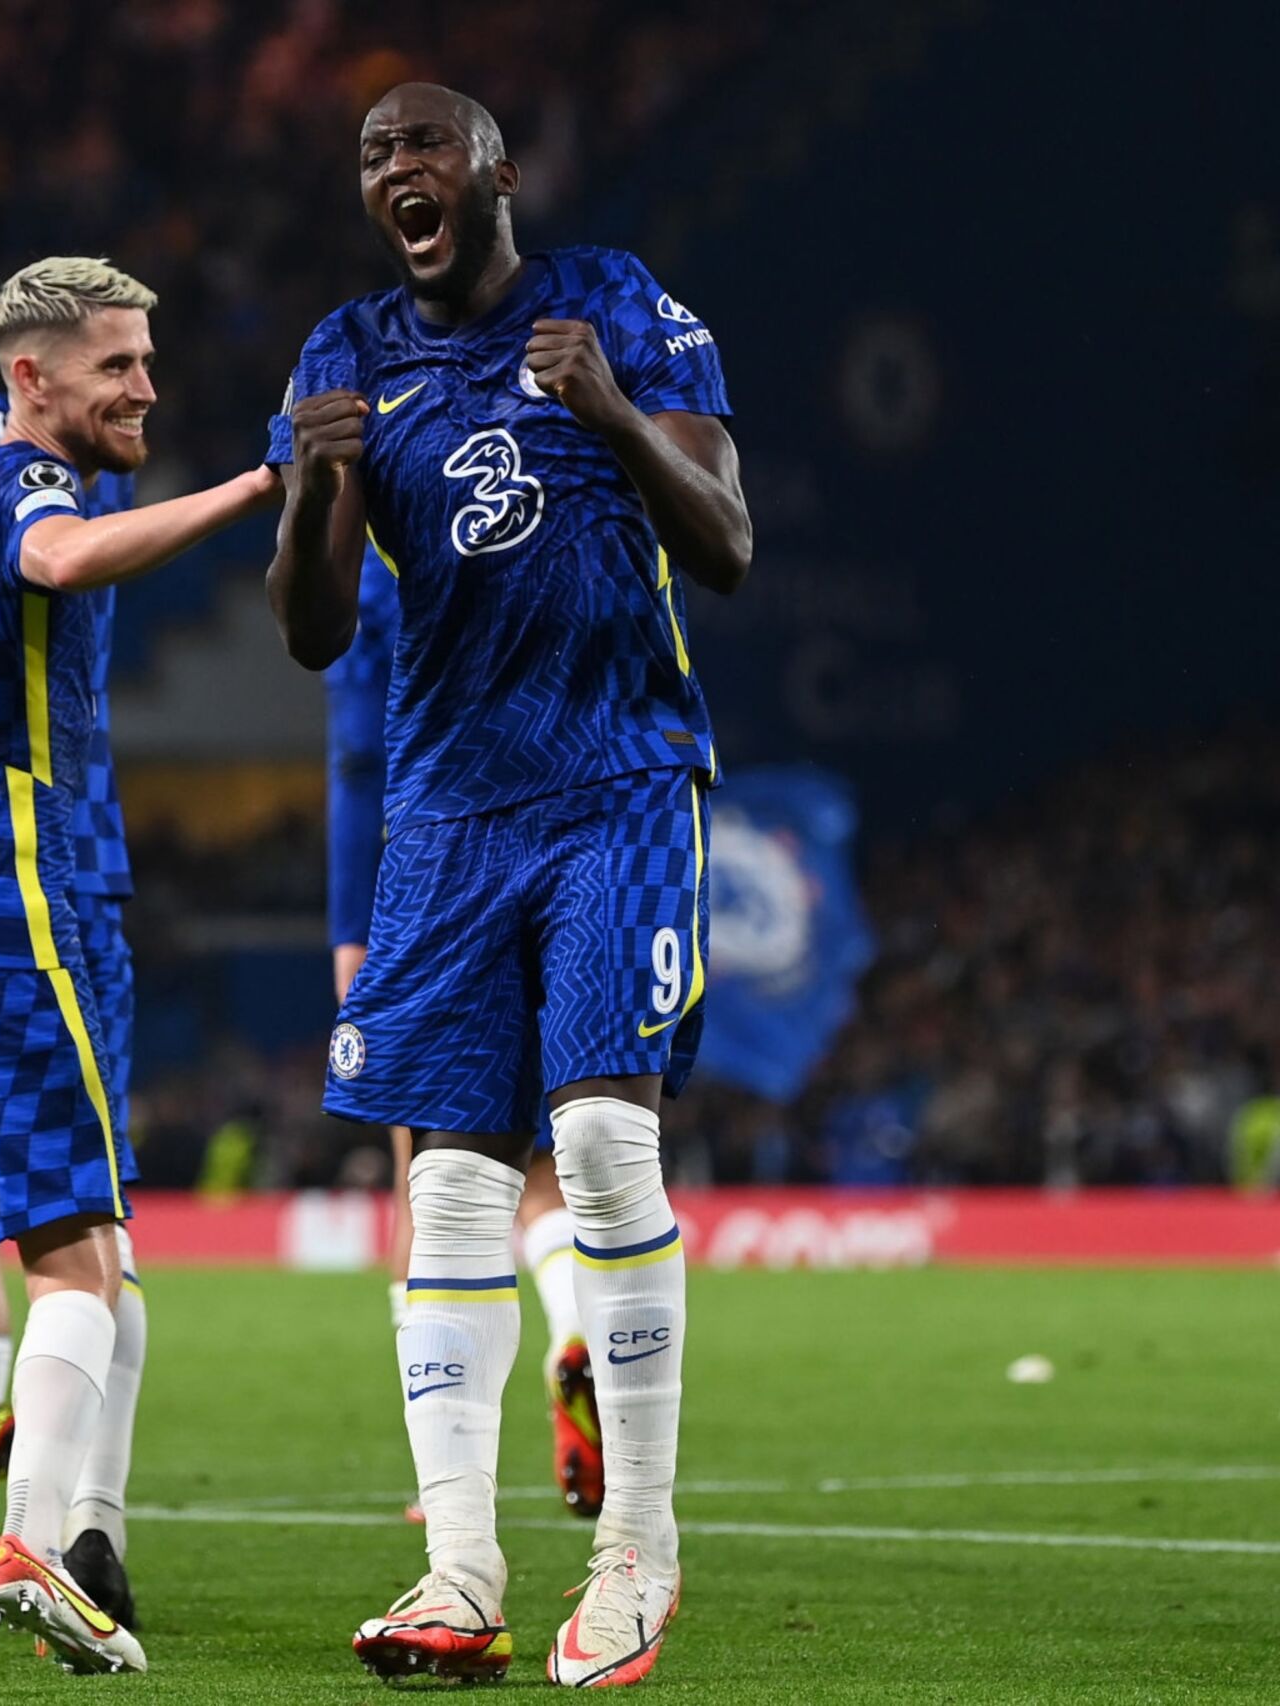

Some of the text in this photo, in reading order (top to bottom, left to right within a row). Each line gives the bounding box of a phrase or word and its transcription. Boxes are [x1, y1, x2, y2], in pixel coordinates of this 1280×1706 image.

[665, 328, 714, 355] HYUN
[651, 927, 681, 1015] 9
[609, 1327, 670, 1345] CFC
[408, 1362, 464, 1378] CFC
